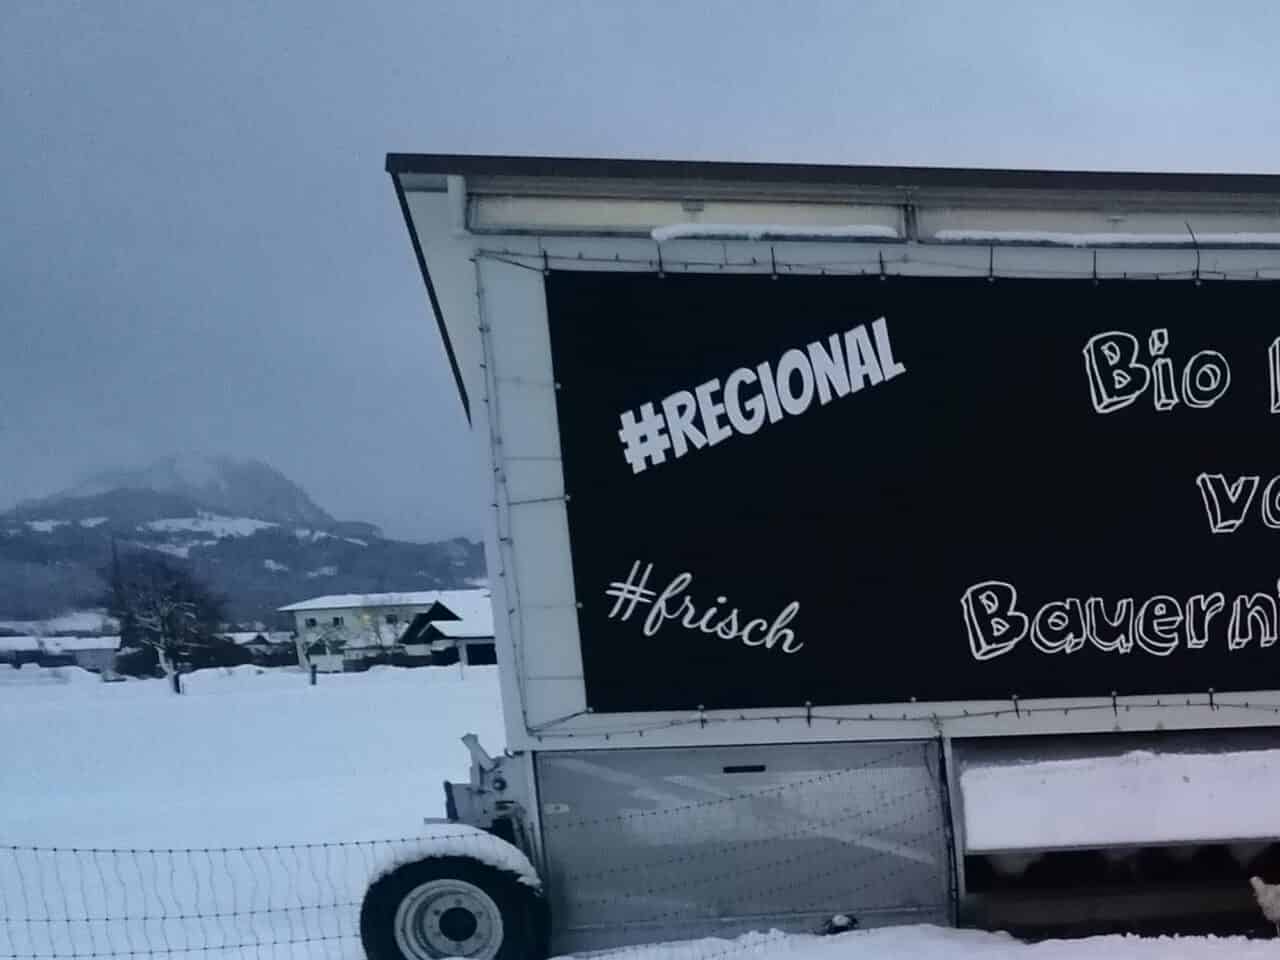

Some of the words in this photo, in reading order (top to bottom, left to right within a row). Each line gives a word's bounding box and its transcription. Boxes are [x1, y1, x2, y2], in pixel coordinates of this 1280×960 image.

[618, 315, 907, 474] #REGIONAL
[1082, 328, 1231, 414] Bio
[606, 560, 804, 654] #frisch
